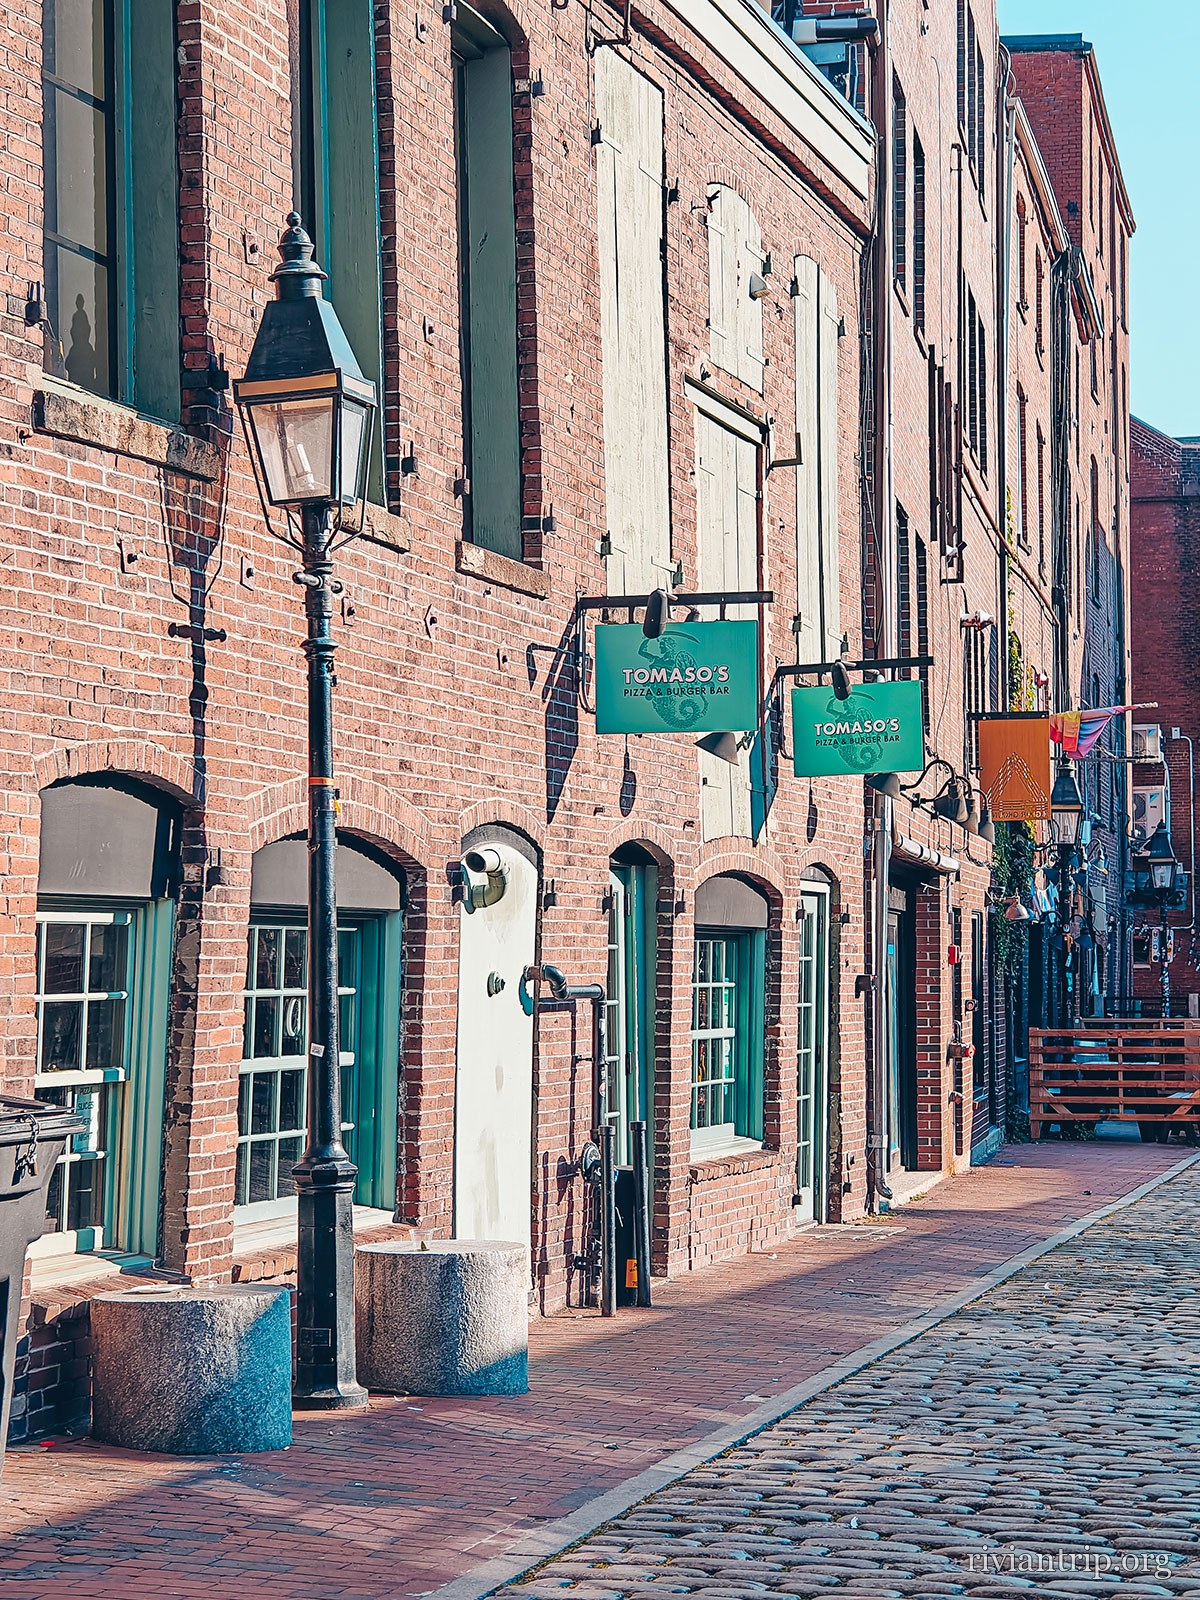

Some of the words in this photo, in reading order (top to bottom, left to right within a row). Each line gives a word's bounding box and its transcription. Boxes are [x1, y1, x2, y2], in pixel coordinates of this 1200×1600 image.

[622, 666, 730, 684] TOMASO'S
[623, 688, 653, 697] PIZZA
[656, 688, 663, 696] &
[666, 687, 706, 695] BURGER
[709, 686, 730, 695] BAR
[814, 719, 900, 736] TOMASO'S
[849, 736, 882, 744] BURGER
